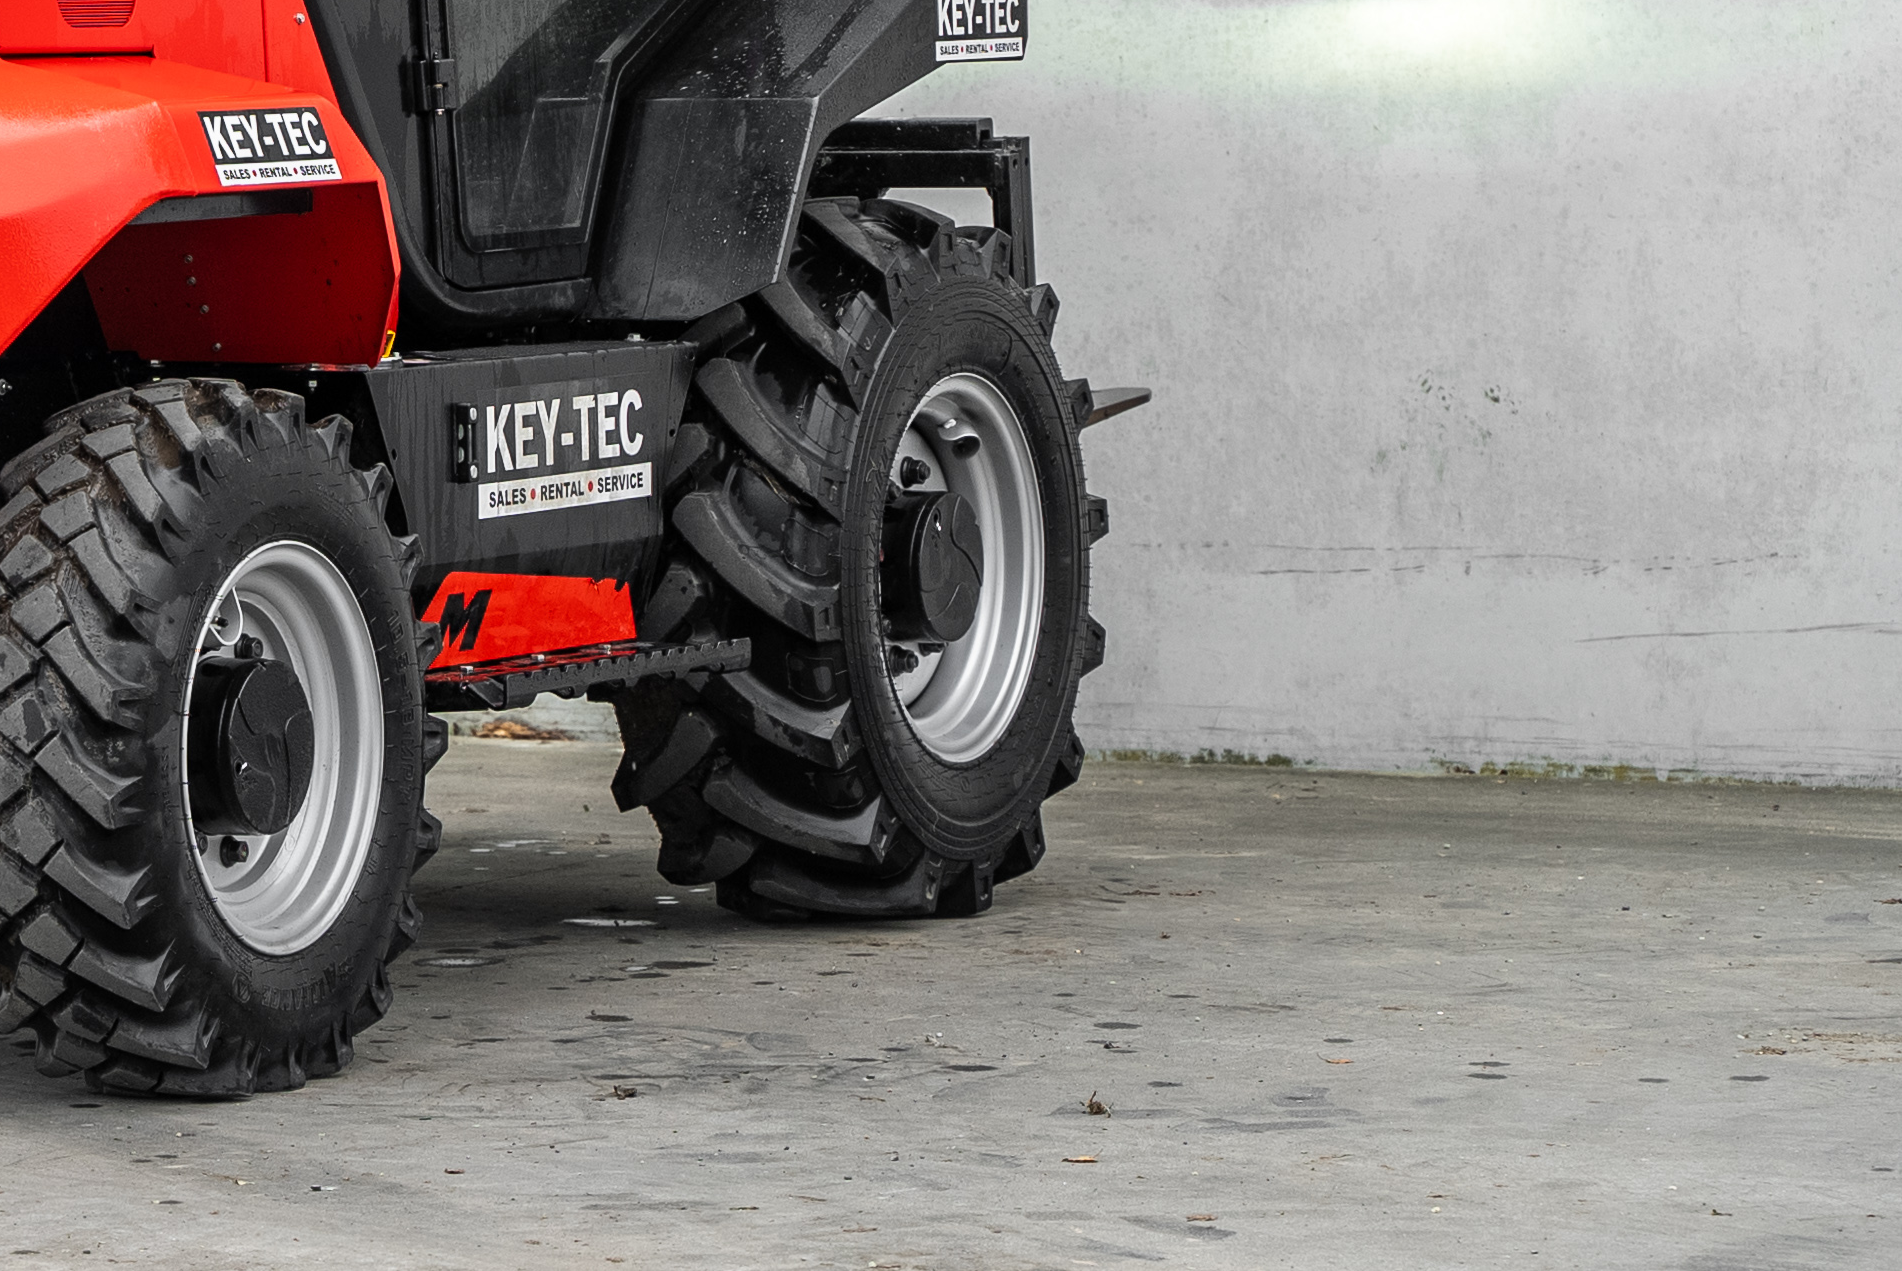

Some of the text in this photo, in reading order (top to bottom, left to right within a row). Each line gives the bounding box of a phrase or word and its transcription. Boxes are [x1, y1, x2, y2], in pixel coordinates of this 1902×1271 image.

[940, 42, 1020, 55] SALES RENTAL SERVICE
[203, 111, 327, 160] KEY-TEC
[223, 164, 336, 180] SALES RENTAL SERVICE
[486, 389, 644, 474] KEY-TEC
[489, 472, 644, 508] SALES RENTAL SERVICE
